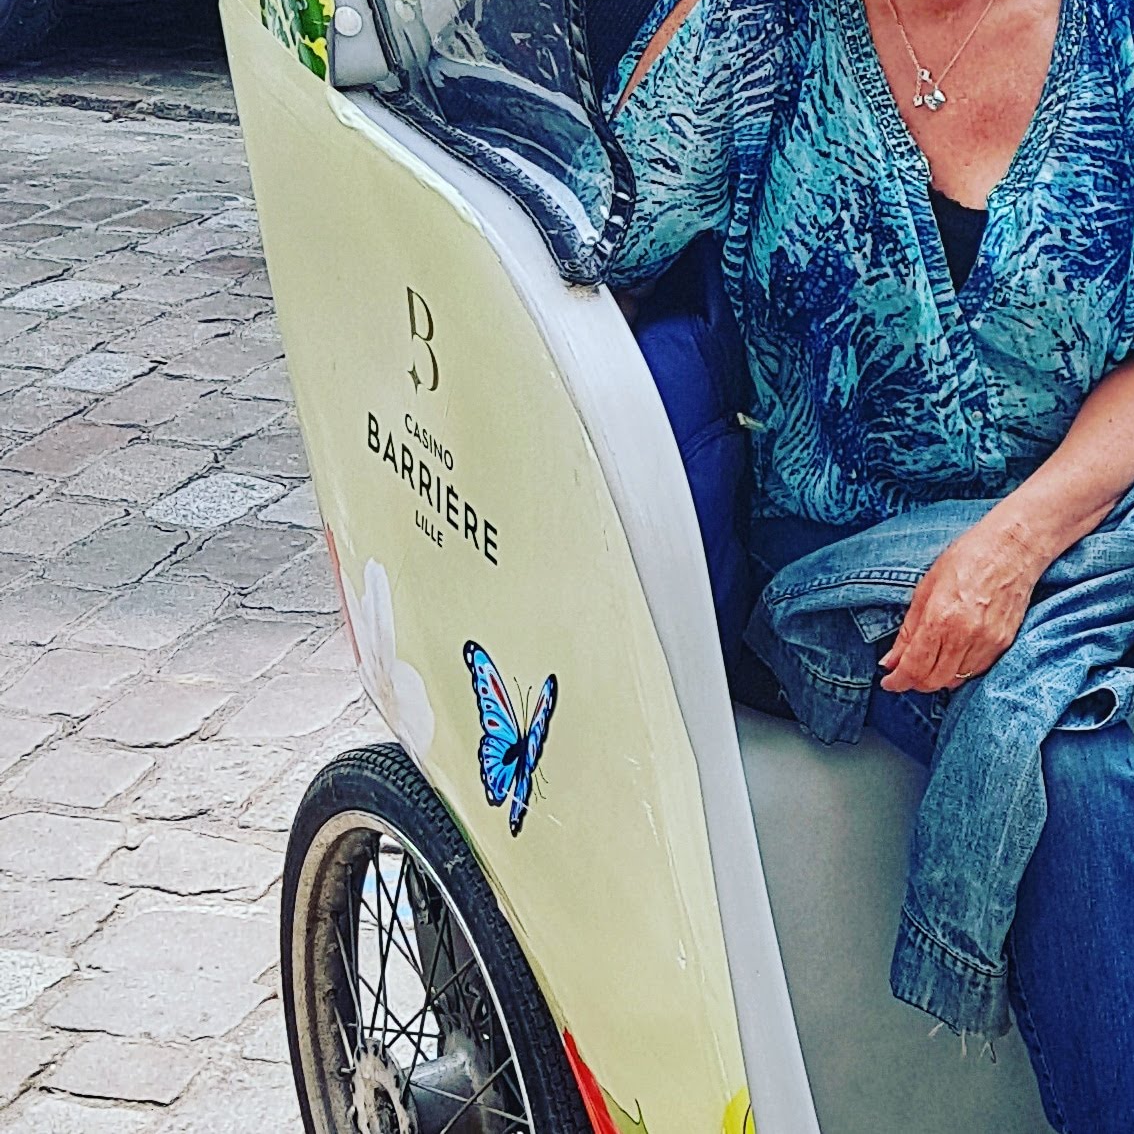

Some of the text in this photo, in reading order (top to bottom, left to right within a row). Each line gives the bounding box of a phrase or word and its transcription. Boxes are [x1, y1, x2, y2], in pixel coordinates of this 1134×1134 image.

[404, 413, 454, 472] CASINO
[367, 411, 499, 567] BARRIÈRE
[415, 509, 445, 549] LILLE
